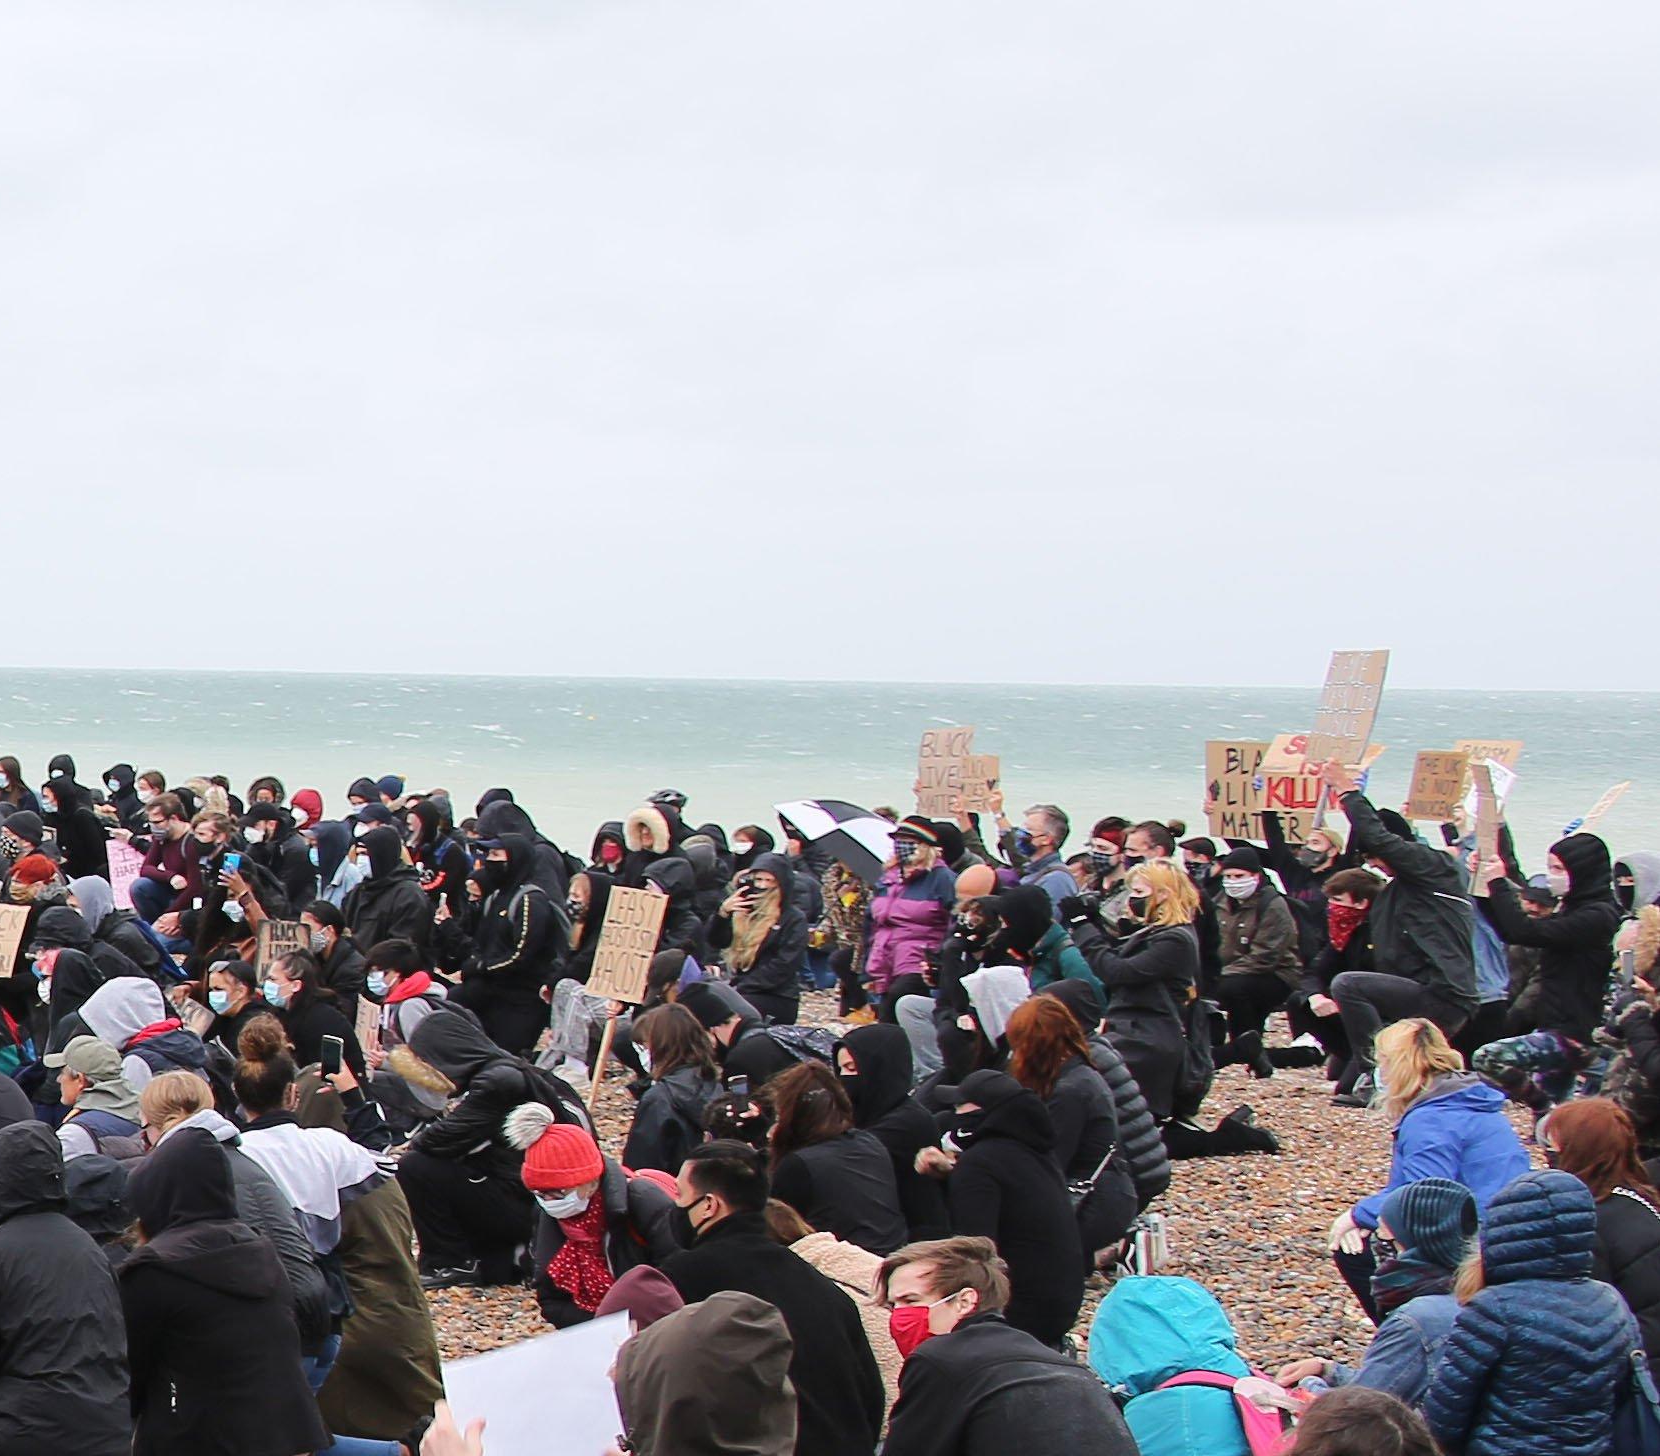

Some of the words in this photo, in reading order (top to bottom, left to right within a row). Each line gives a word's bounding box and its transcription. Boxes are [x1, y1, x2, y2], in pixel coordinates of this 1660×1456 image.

[921, 731, 973, 758] BLACK
[1419, 757, 1440, 774] THE
[1444, 758, 1461, 774] UK
[608, 890, 663, 927] LEAST
